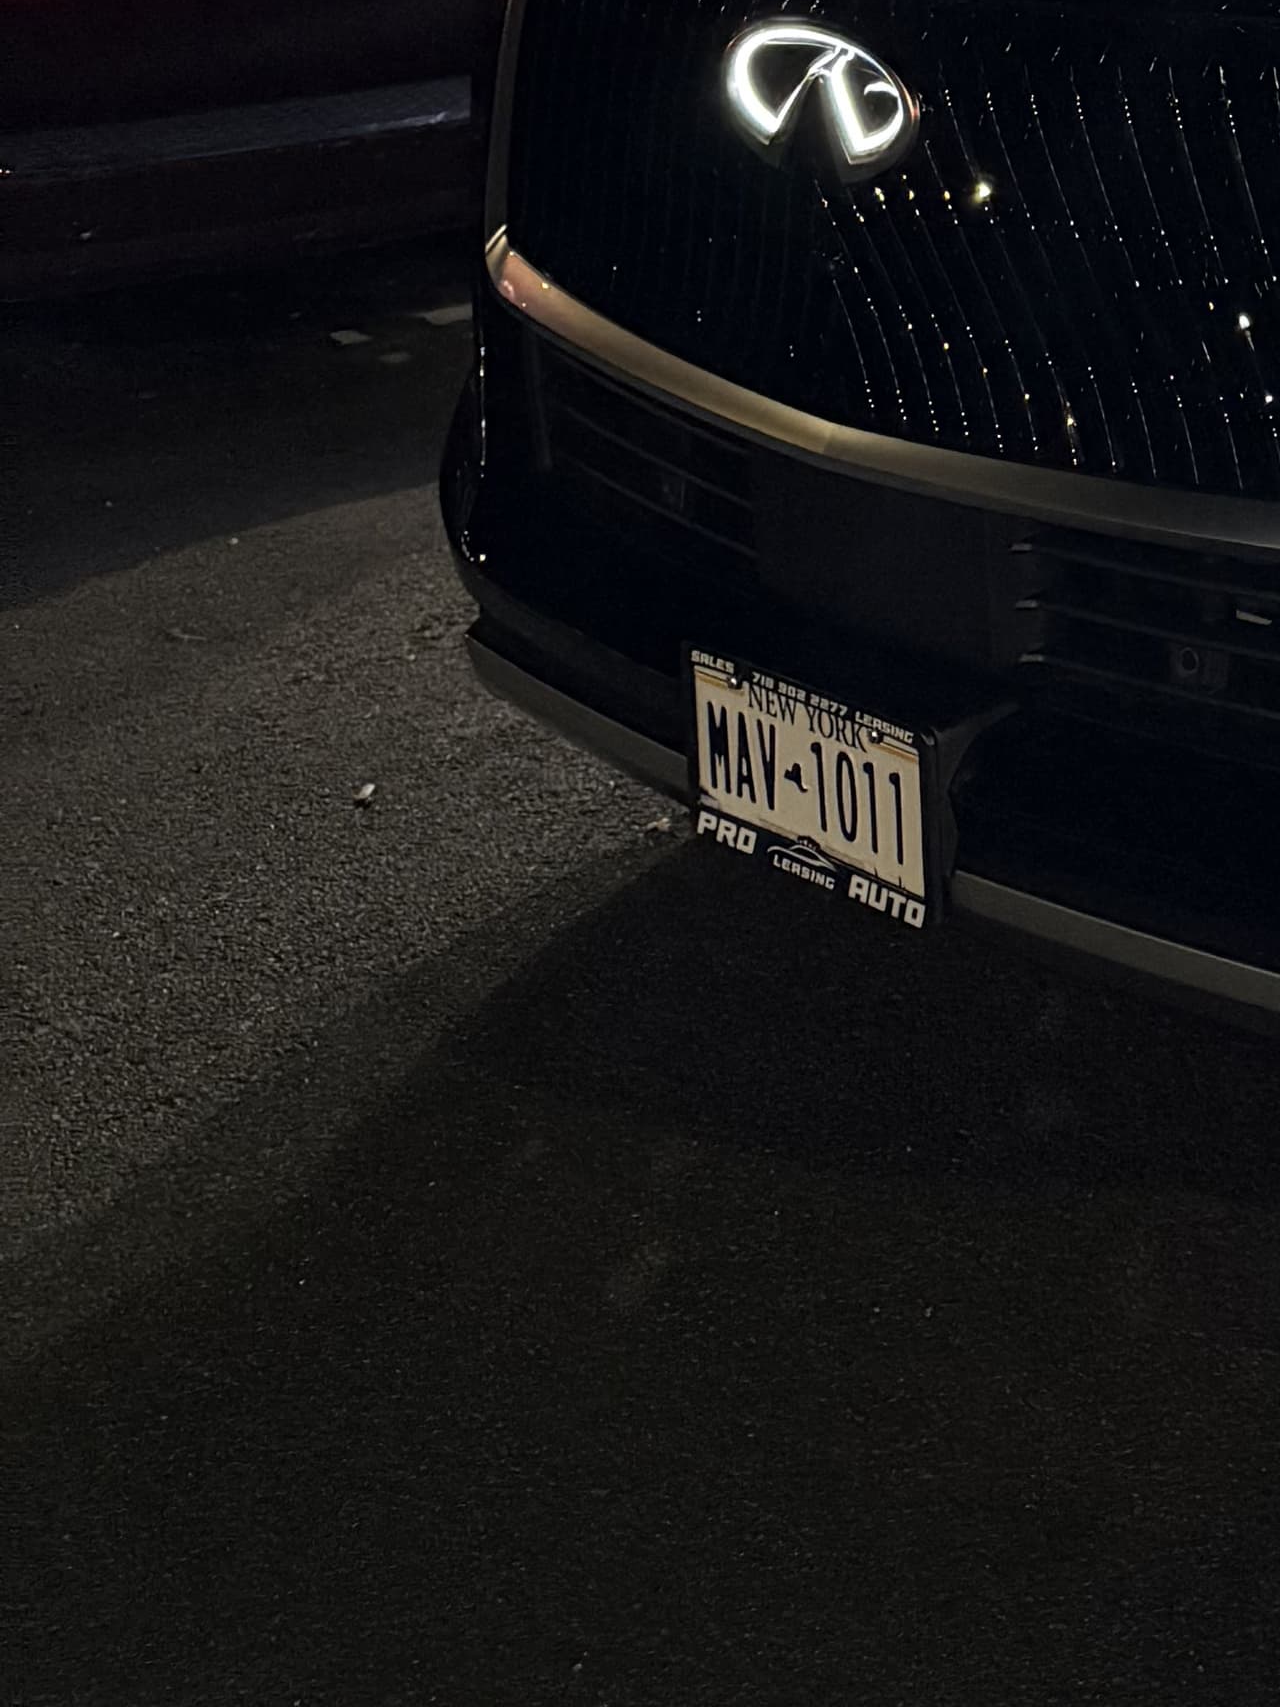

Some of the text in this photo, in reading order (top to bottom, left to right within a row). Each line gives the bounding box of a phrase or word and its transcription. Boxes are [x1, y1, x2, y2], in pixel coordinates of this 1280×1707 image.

[690, 650, 735, 674] SALES
[809, 692, 848, 717] 2277
[854, 710, 915, 744] LEASING
[747, 684, 869, 754] NEW YORK
[706, 700, 904, 867] MAV 1011
[697, 809, 927, 930] PRO LEASING AUTO
